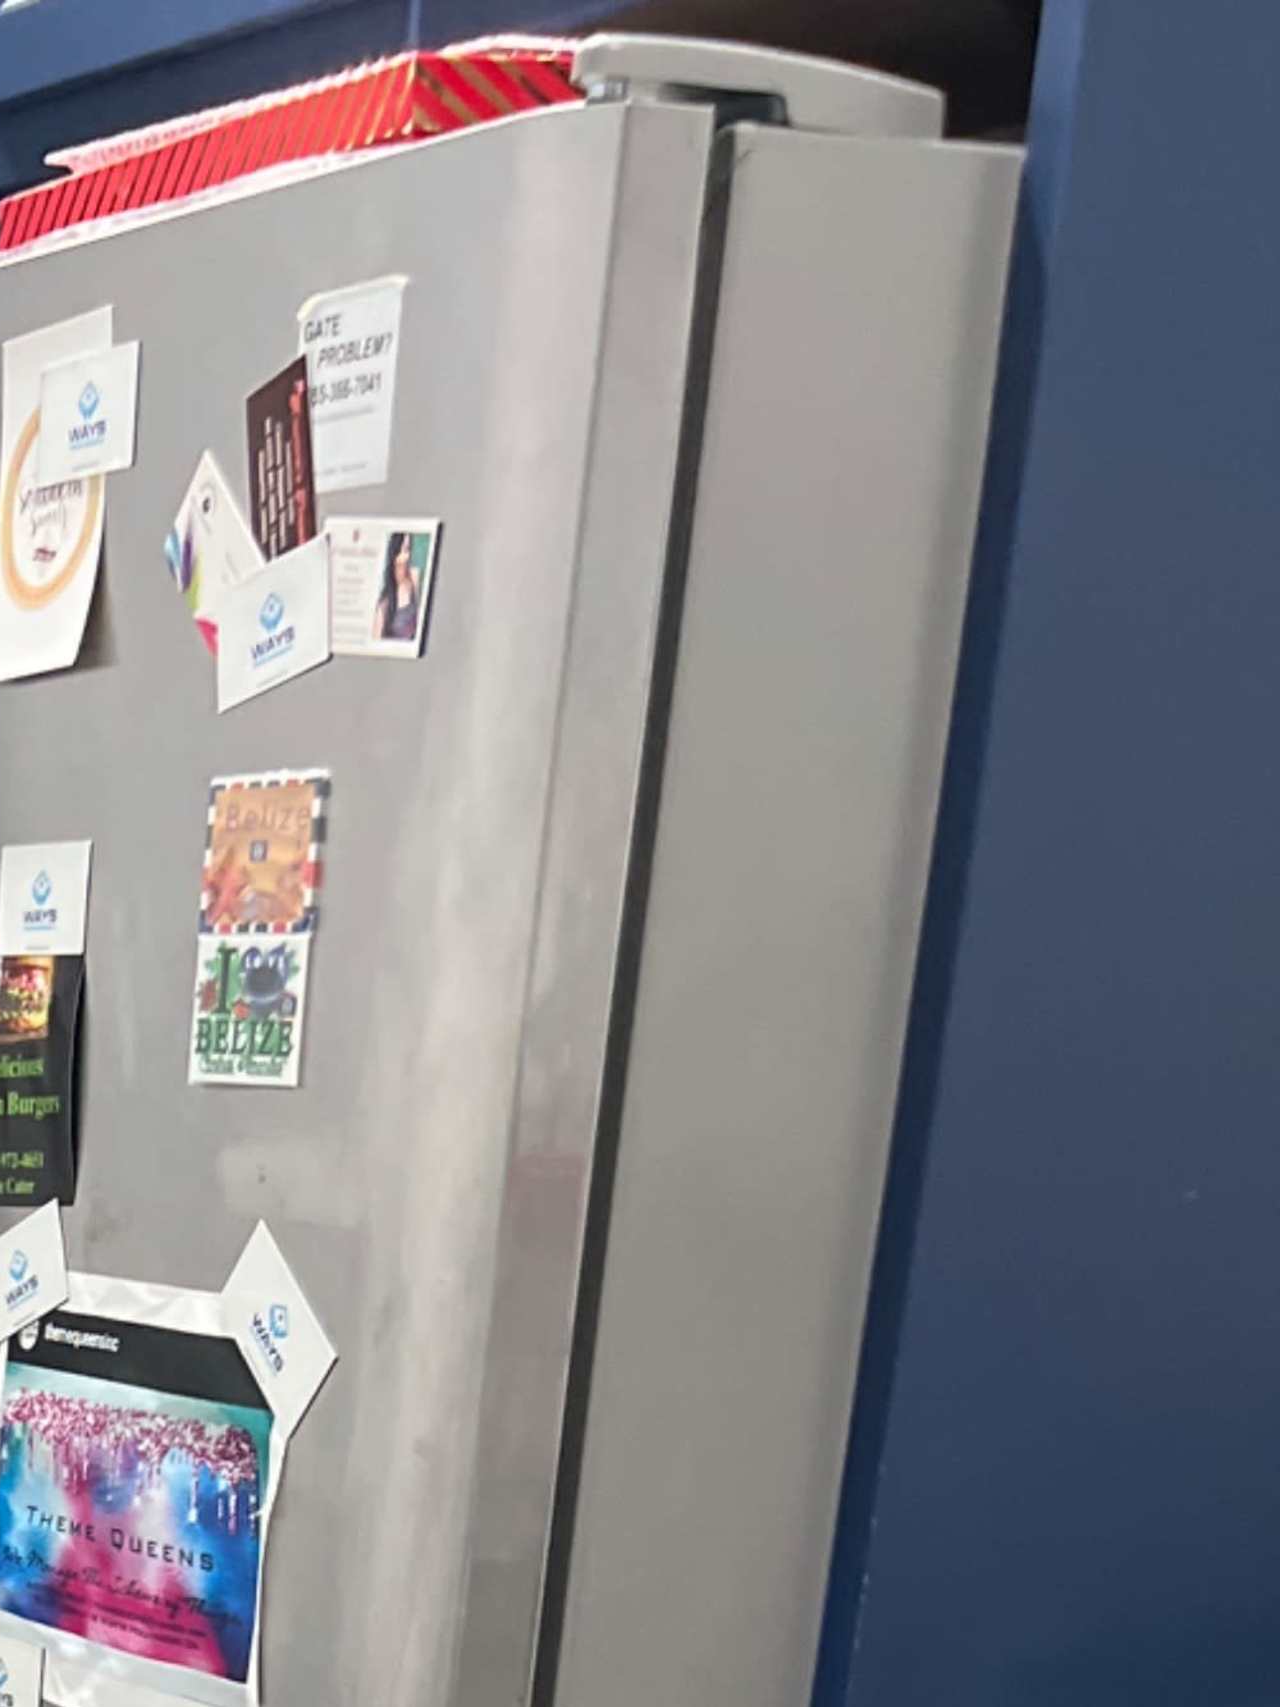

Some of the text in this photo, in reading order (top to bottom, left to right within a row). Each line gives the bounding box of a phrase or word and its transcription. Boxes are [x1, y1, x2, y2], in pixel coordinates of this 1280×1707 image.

[304, 314, 342, 343] GATE
[317, 331, 394, 368] PROBLEM?
[67, 419, 107, 443] WAYS
[251, 625, 296, 660] WAYS
[194, 1017, 295, 1057] BELIZE
[6, 1091, 61, 1121] Burgers
[253, 1311, 284, 1373] WAYS
[26, 1505, 215, 1572] THEME QUEENS
